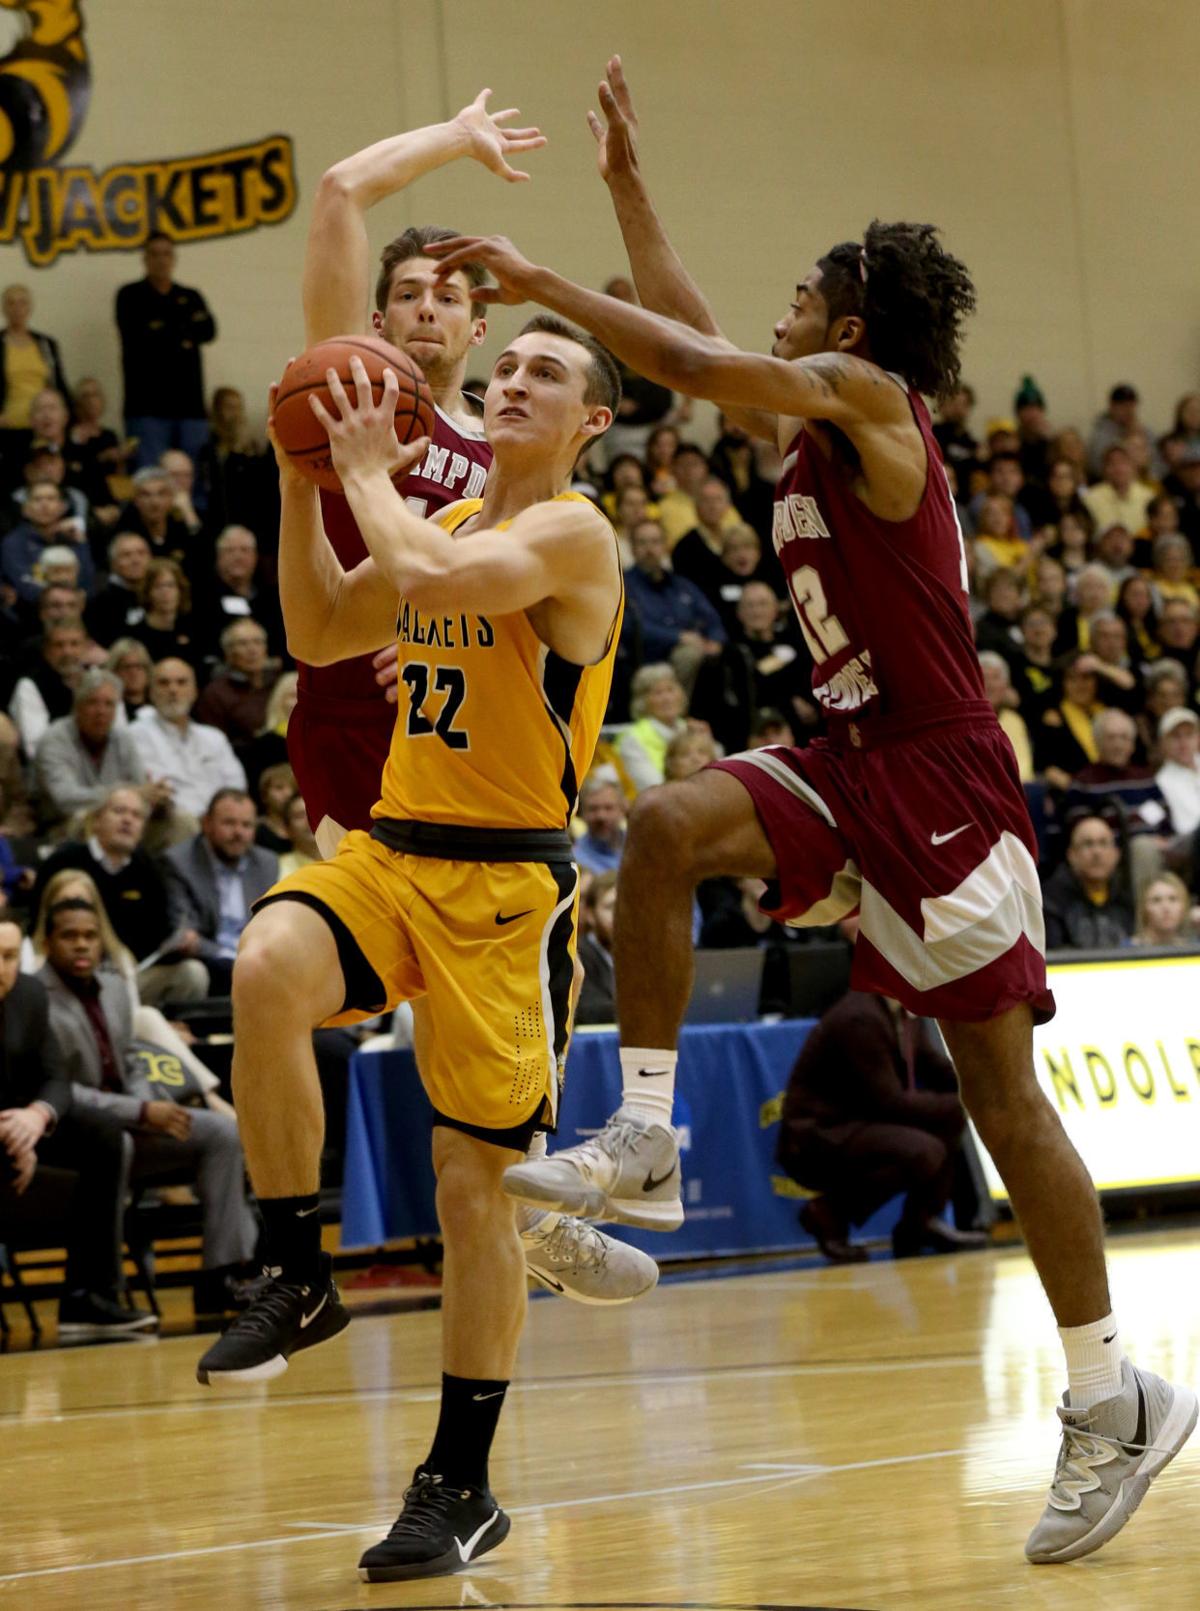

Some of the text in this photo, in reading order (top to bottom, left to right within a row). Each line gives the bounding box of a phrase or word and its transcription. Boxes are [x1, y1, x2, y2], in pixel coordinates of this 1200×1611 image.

[31, 144, 291, 257] JACKETS
[409, 444, 487, 499] MPD
[402, 663, 471, 752] 22
